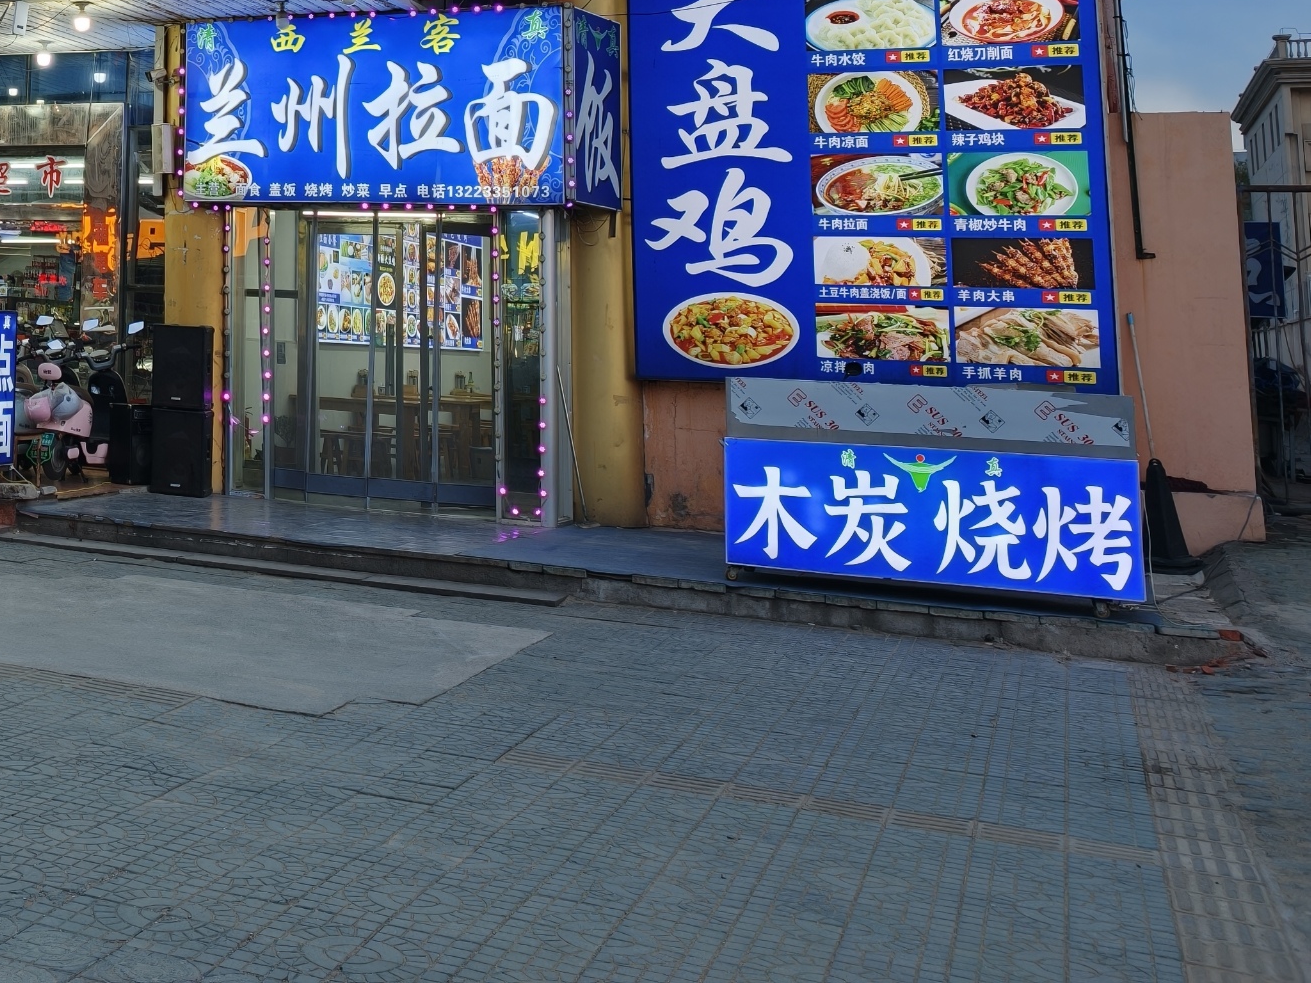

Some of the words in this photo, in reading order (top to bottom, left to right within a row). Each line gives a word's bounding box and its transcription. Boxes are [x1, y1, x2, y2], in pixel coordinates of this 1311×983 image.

[811, 50, 865, 67] 牛肉水饺
[904, 51, 928, 62] 推荐
[948, 46, 1013, 62] 红烧刀削面
[1052, 46, 1076, 56] 推荐
[188, 53, 558, 179] 兰州拉面
[814, 135, 868, 149] 牛肉凉面
[911, 136, 936, 147] 推荐
[952, 133, 1005, 147] 辣子鸡块
[1055, 134, 1079, 144] 推荐
[269, 183, 296, 197] 盖饭
[304, 183, 333, 197] 烧烤
[341, 183, 370, 197] 炒菜
[378, 183, 408, 198] 早点
[818, 218, 868, 231] 牛肉拉面
[915, 219, 939, 230] 推荐
[954, 217, 1026, 232] 青椒炒牛肉
[1059, 219, 1083, 231] 推荐
[819, 287, 906, 300] 土豆牛肉盖浇饭/面
[924, 289, 942, 300] 推荐
[958, 289, 1015, 303] 羊肉大串
[1063, 292, 1087, 302] 推荐
[820, 361, 874, 375] 凉拌肉
[926, 366, 945, 376] 推荐
[963, 366, 1022, 381] 手抓羊肉
[1068, 372, 1093, 382] 推荐
[732, 466, 1133, 592] 木炭烧烤
